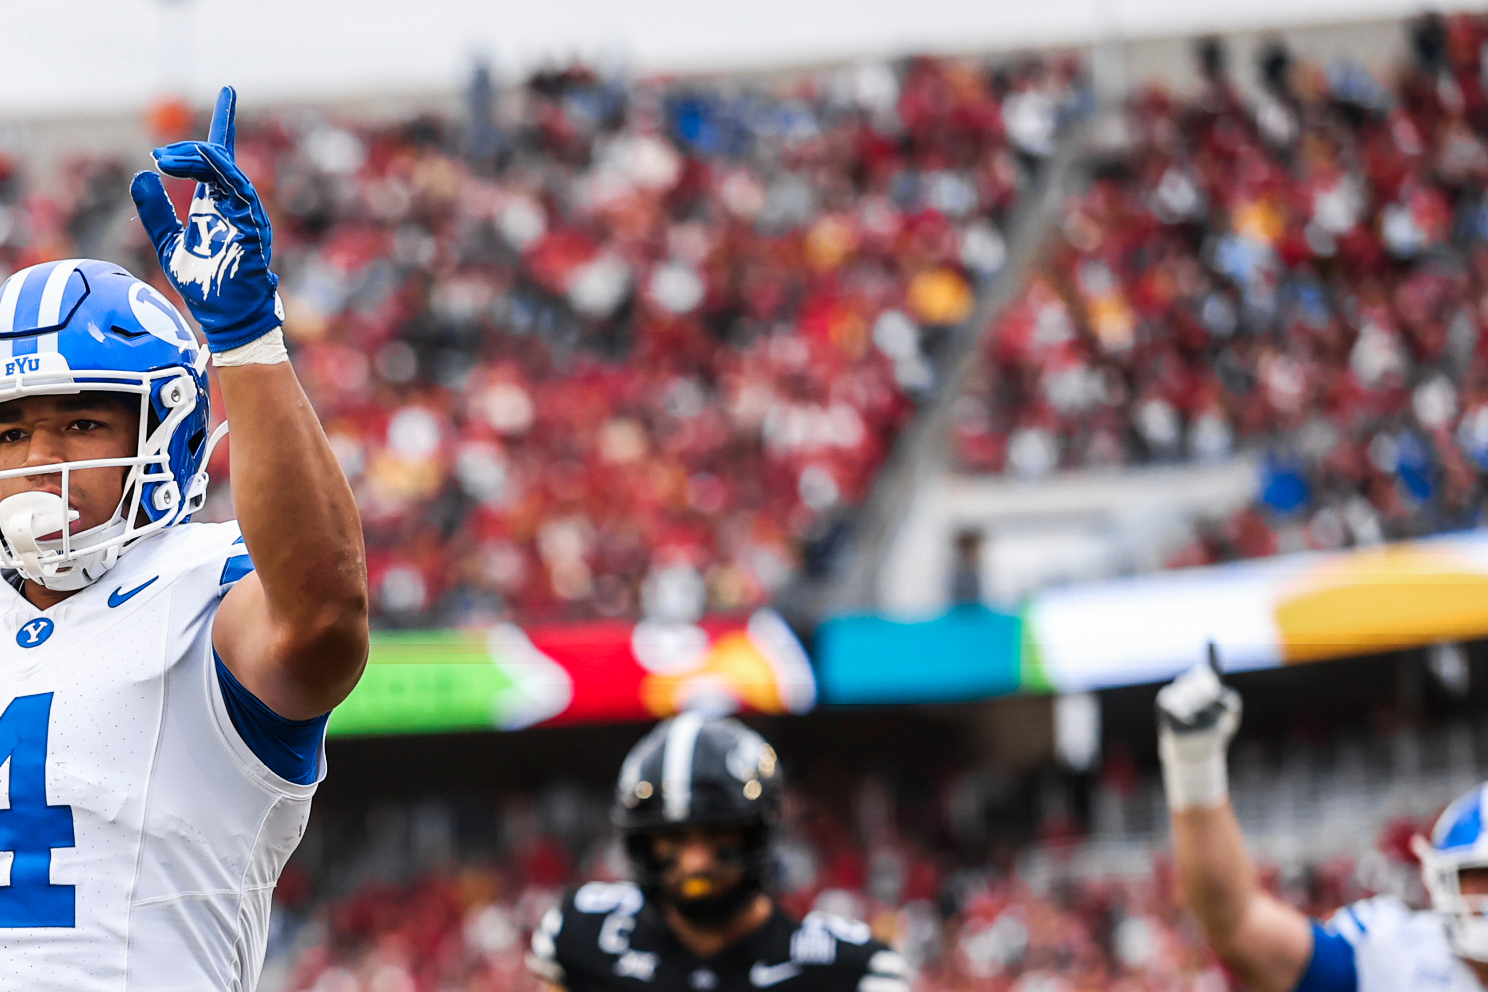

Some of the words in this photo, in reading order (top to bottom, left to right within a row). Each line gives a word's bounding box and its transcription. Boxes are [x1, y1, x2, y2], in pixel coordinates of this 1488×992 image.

[136, 287, 193, 342] Y
[5, 356, 40, 377] BYU
[22, 621, 49, 646] Y
